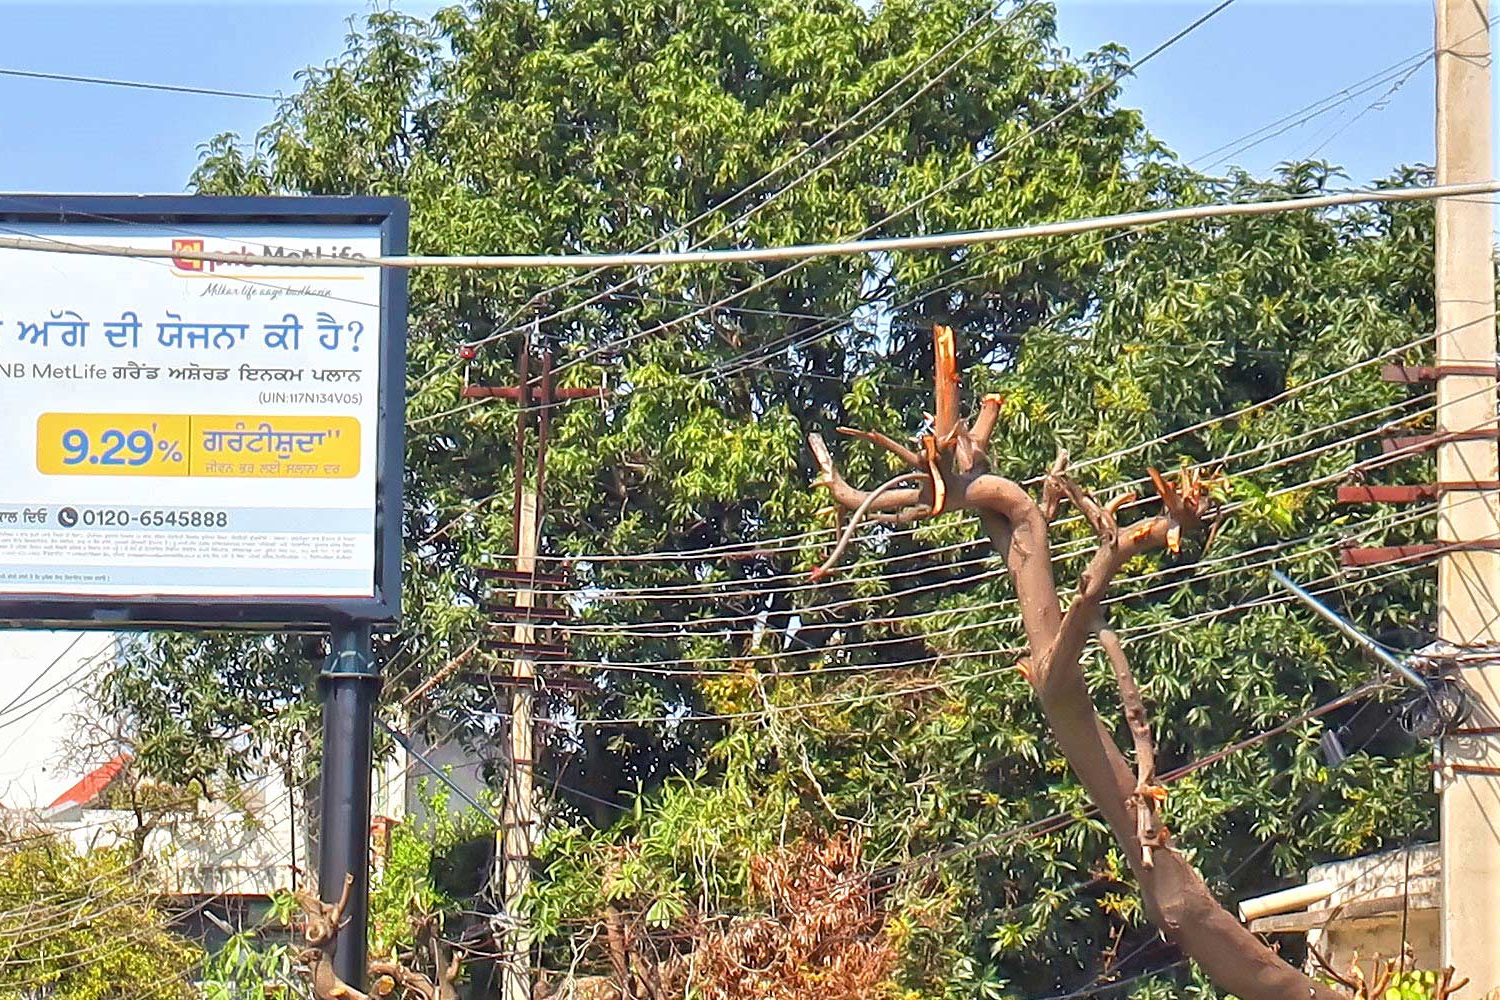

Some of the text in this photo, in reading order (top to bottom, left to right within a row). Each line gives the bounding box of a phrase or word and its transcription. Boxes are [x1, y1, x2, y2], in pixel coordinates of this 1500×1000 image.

[16, 309, 90, 347] ਅੱਗੇ
[103, 311, 143, 348] ਦੀ
[156, 310, 250, 349] ਯੋਜਨਾ
[263, 313, 304, 350] ਕੀ
[32, 363, 107, 380] MetLife
[238, 363, 305, 382] ਇਨਕਮ
[311, 368, 363, 383] ਪਲਾਨ
[82, 509, 228, 528] 0120-6545888
